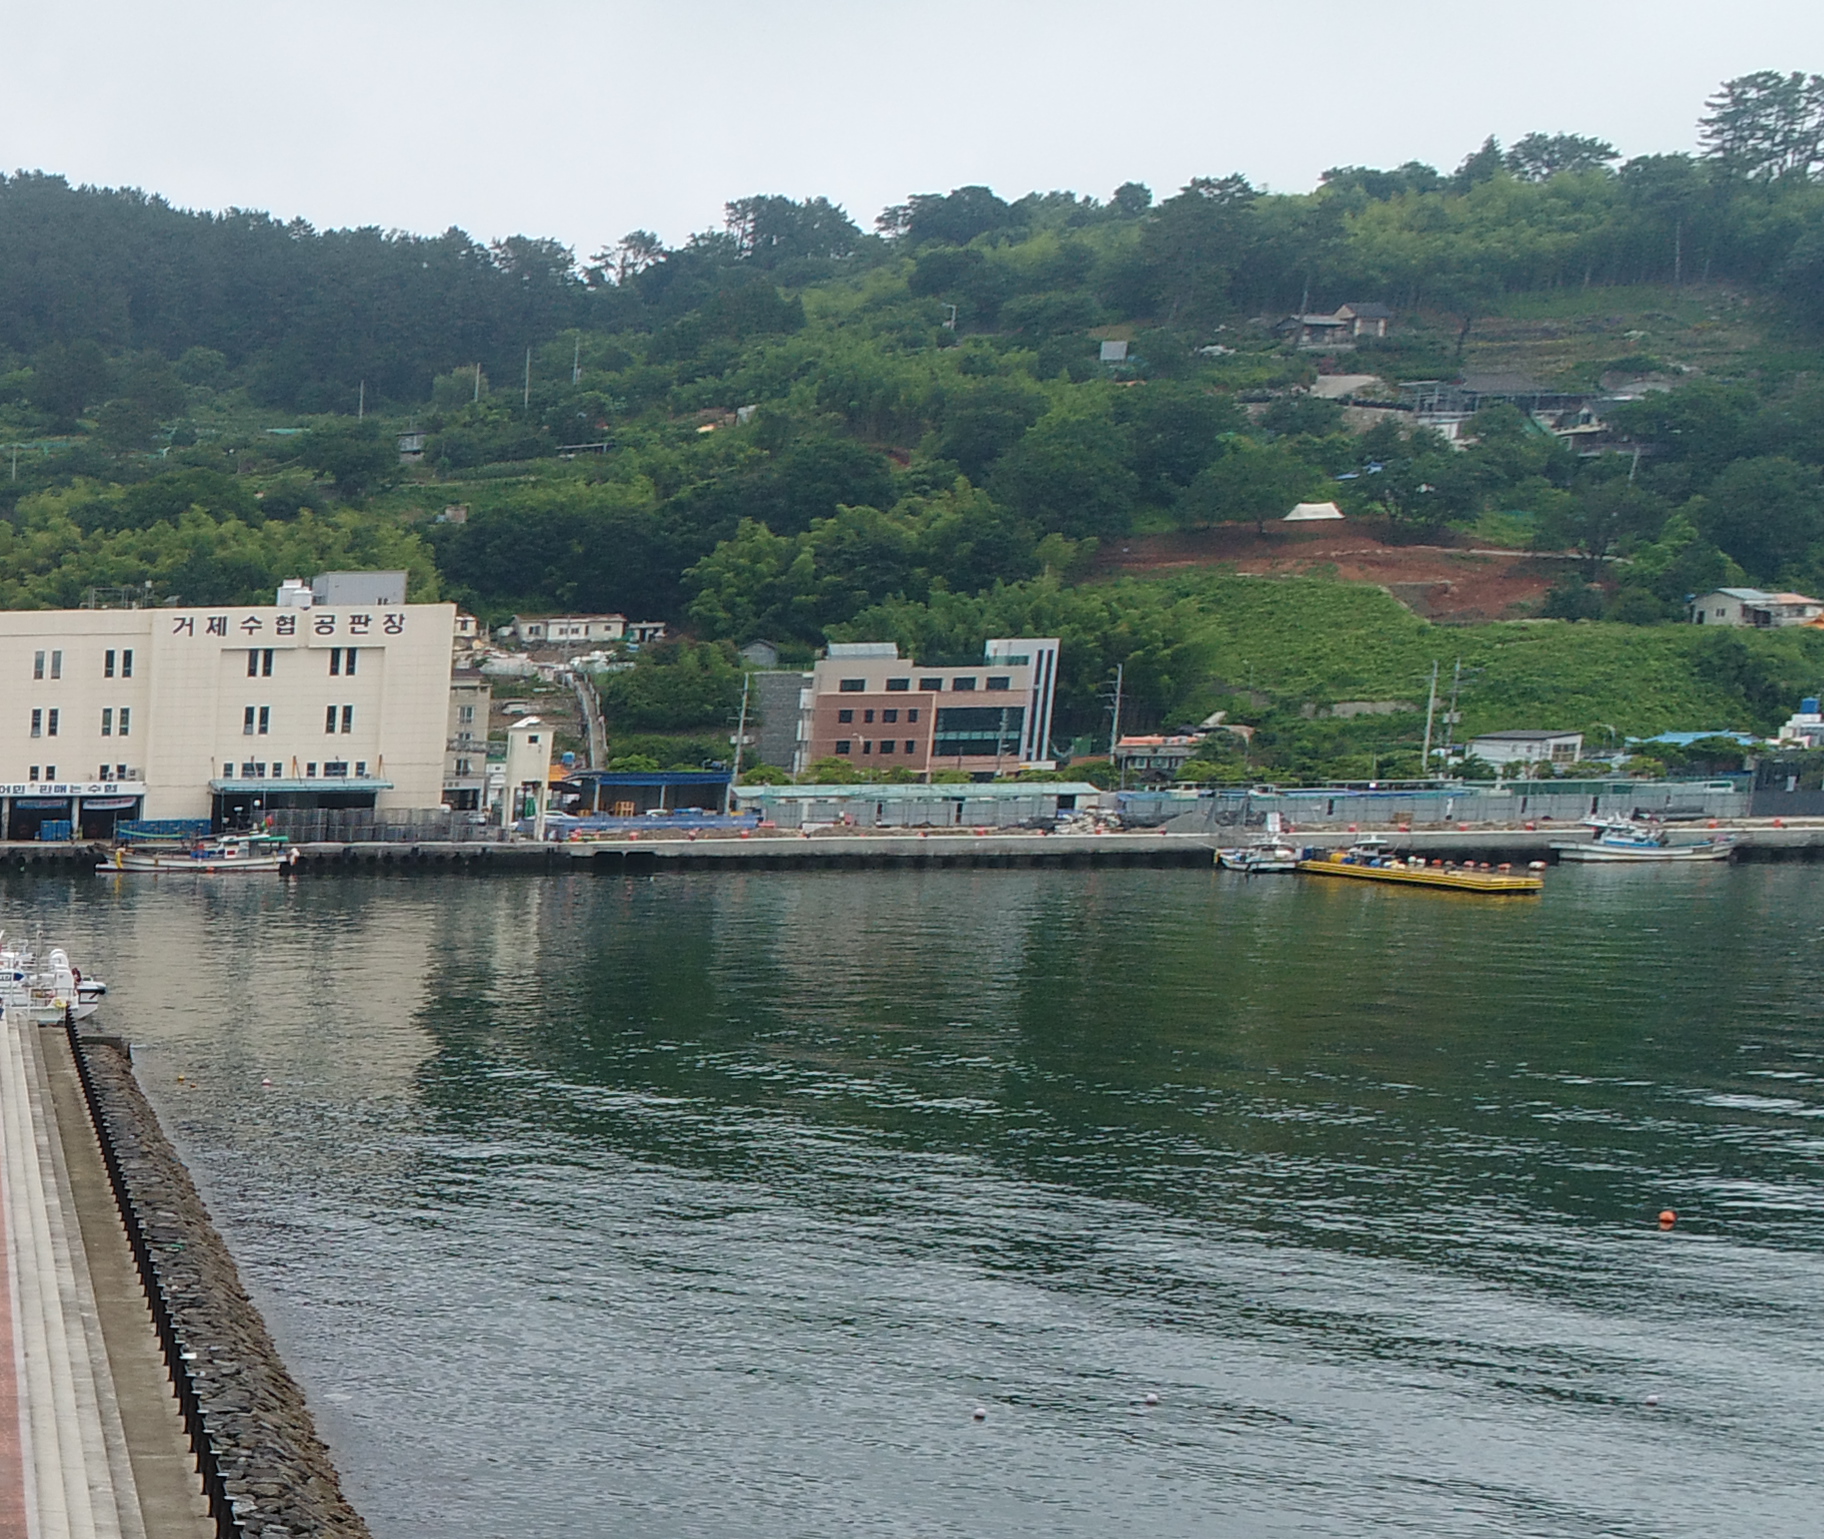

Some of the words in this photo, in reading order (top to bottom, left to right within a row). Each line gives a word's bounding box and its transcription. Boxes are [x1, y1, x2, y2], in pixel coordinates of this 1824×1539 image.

[172, 614, 296, 637] 거제수협
[313, 612, 405, 636] 공판장
[39, 784, 82, 794] 판매는
[88, 784, 118, 794] 수협
